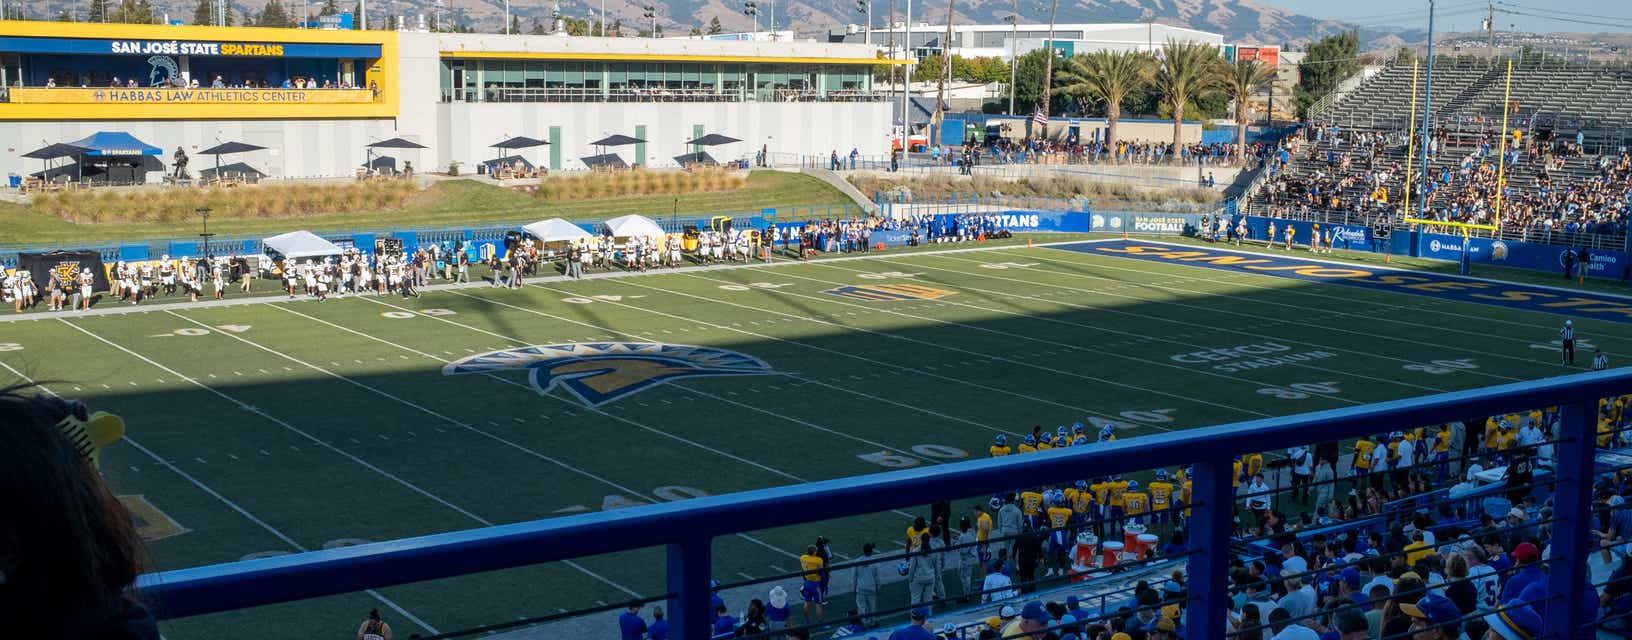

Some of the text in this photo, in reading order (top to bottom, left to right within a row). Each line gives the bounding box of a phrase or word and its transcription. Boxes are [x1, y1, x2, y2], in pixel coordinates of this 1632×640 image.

[111, 40, 284, 57] SAN JOSÉ STATE SPARTANS
[110, 90, 306, 102] HABBAS LAW ATHLETICS CENTER
[1135, 222, 1184, 232] FOOTBALL
[1213, 350, 1340, 373] STADIUM
[1256, 382, 1341, 399] 30
[856, 444, 969, 468] 50
